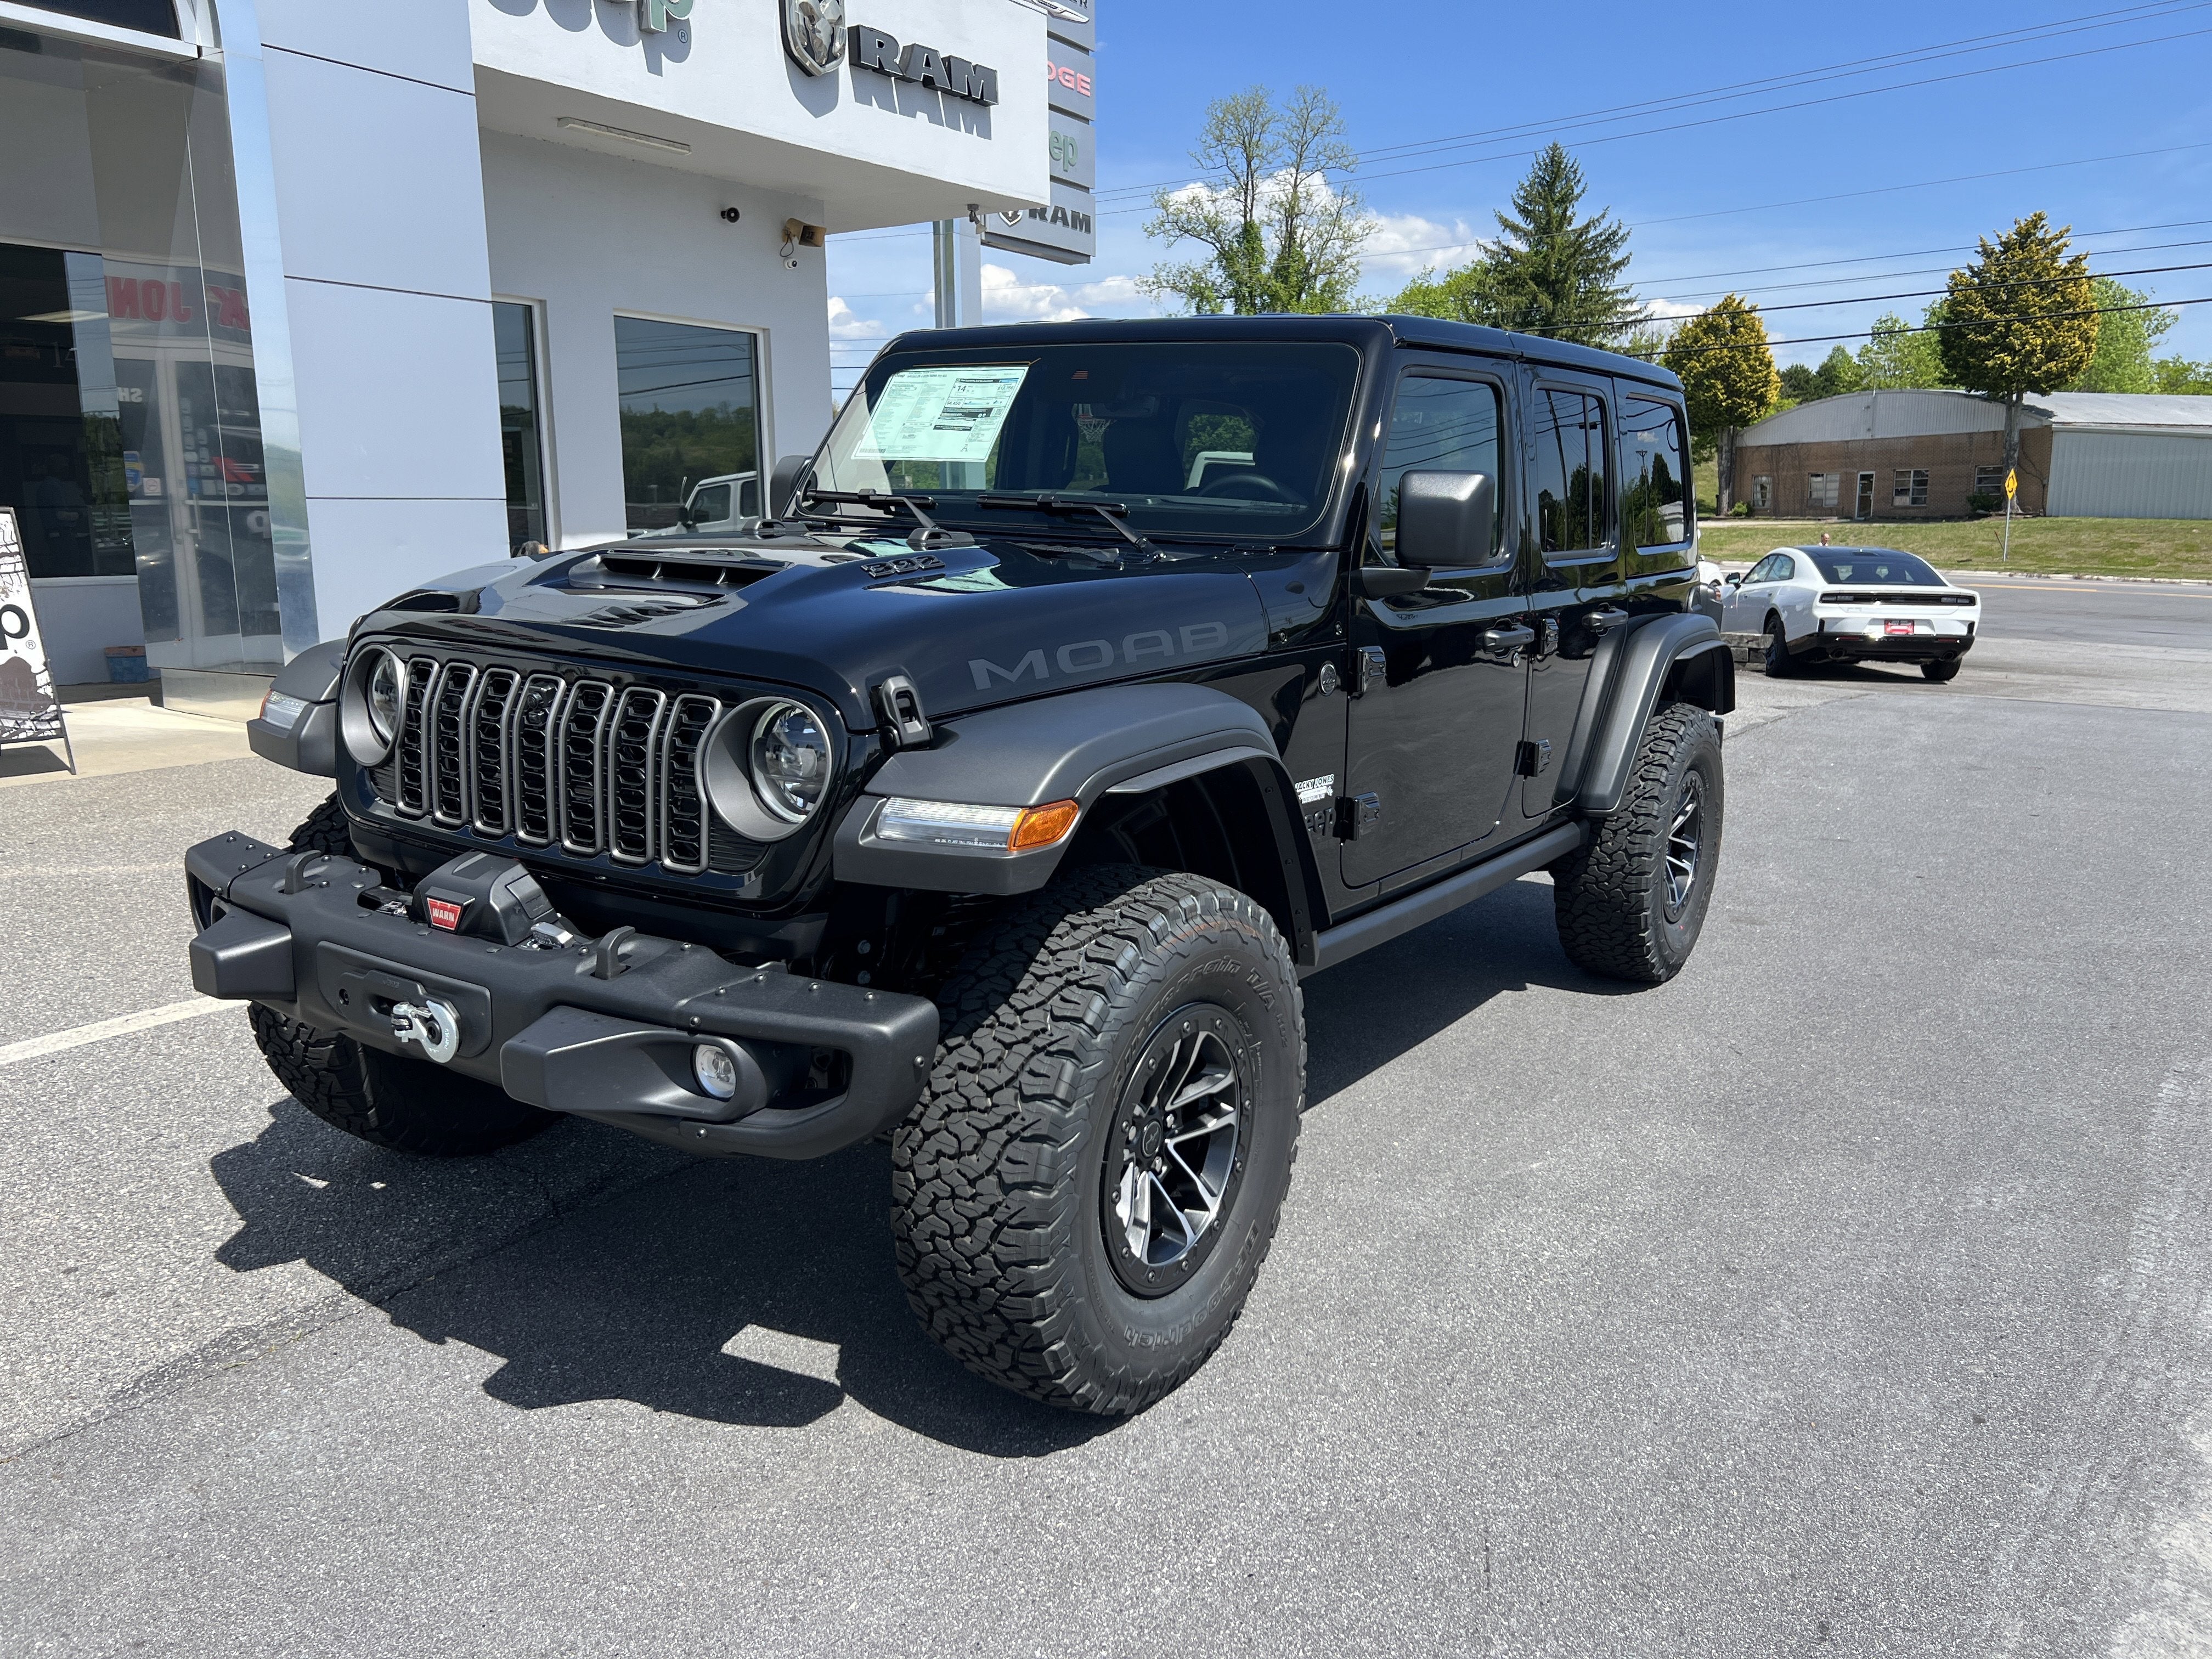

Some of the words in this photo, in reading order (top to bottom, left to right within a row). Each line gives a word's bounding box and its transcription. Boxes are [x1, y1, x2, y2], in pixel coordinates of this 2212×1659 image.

[848, 25, 999, 106] RAM
[1029, 205, 1091, 234] RAM
[860, 555, 946, 579] 392
[968, 621, 1229, 690] MOAB
[1314, 775, 1334, 786] JONES
[432, 907, 454, 922] WARN
